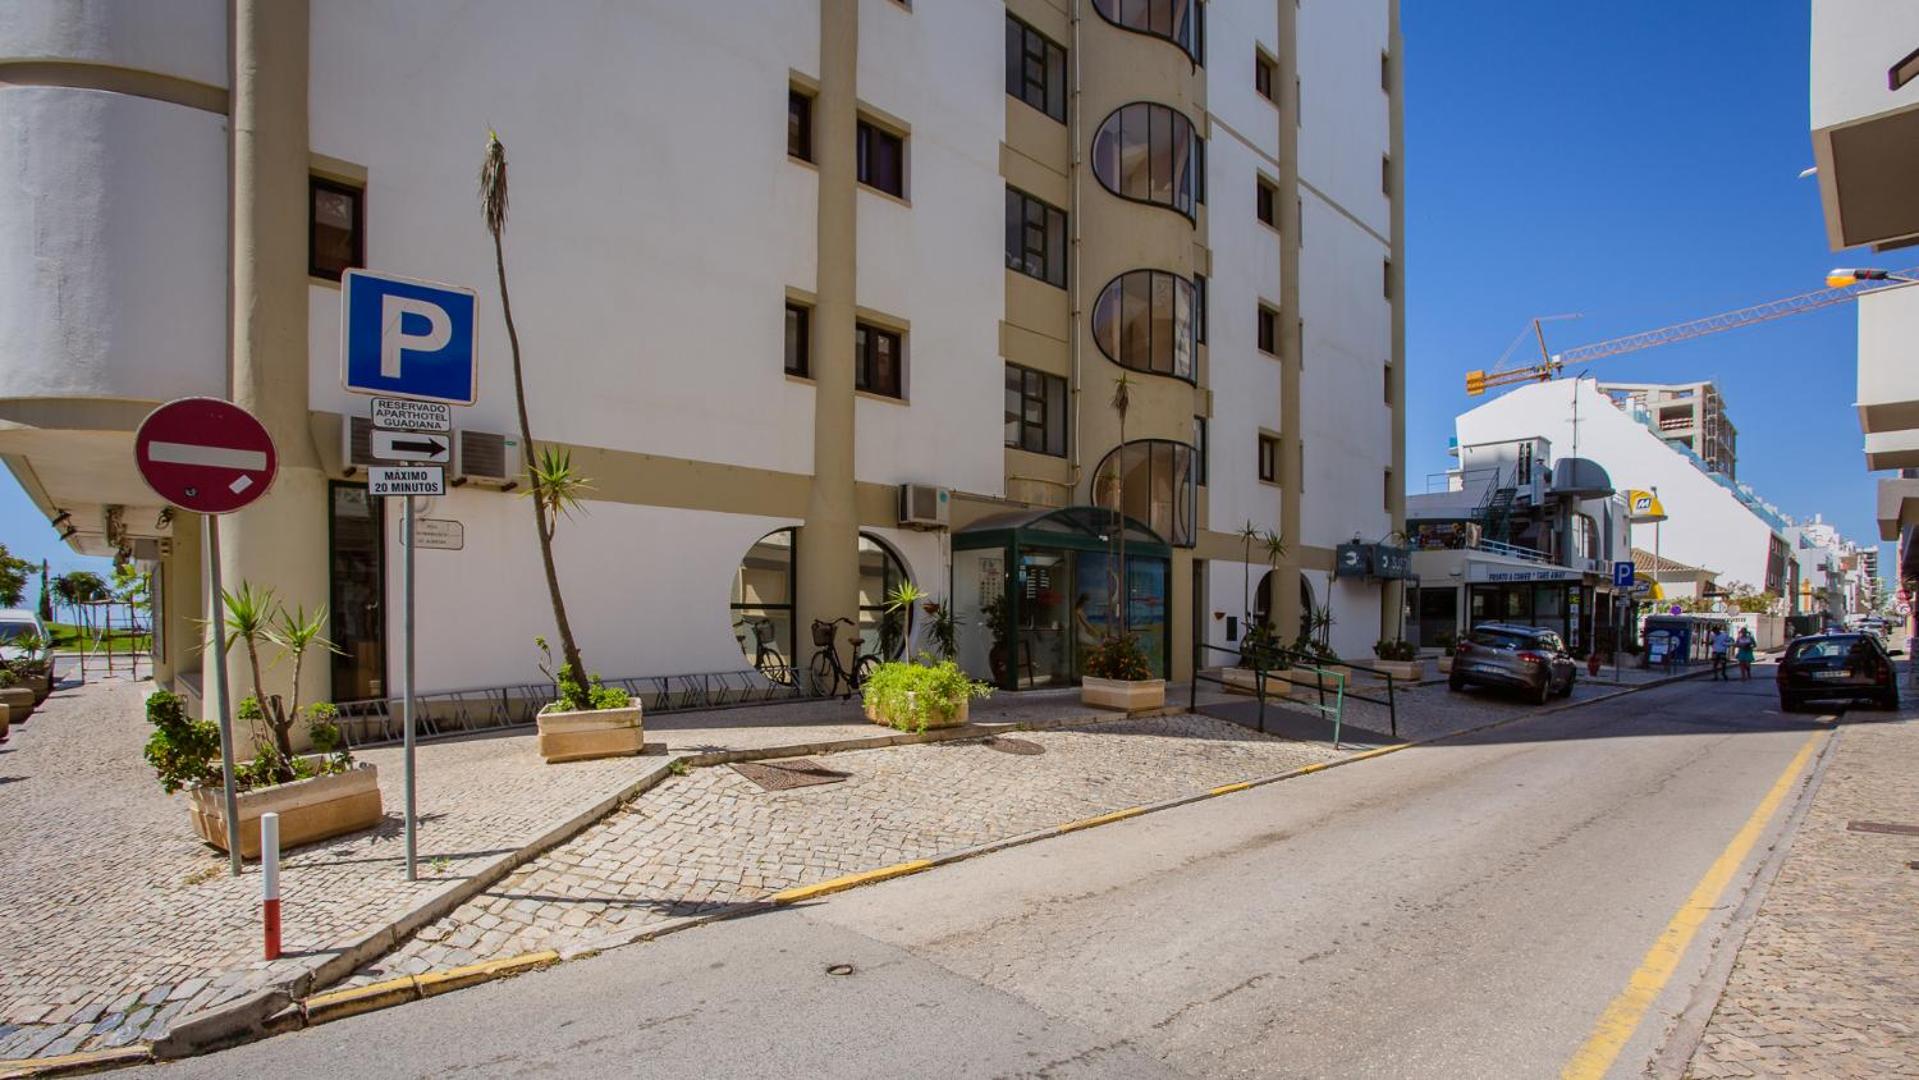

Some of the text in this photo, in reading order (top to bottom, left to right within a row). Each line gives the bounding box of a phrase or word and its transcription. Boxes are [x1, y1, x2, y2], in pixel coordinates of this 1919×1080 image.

[381, 293, 453, 379] P
[378, 400, 446, 413] RESERVADO
[375, 409, 448, 422] APARTHOTEL
[383, 417, 442, 429] GUADIANA
[374, 482, 438, 492] 20 MINUTOS
[1618, 564, 1630, 585] P
